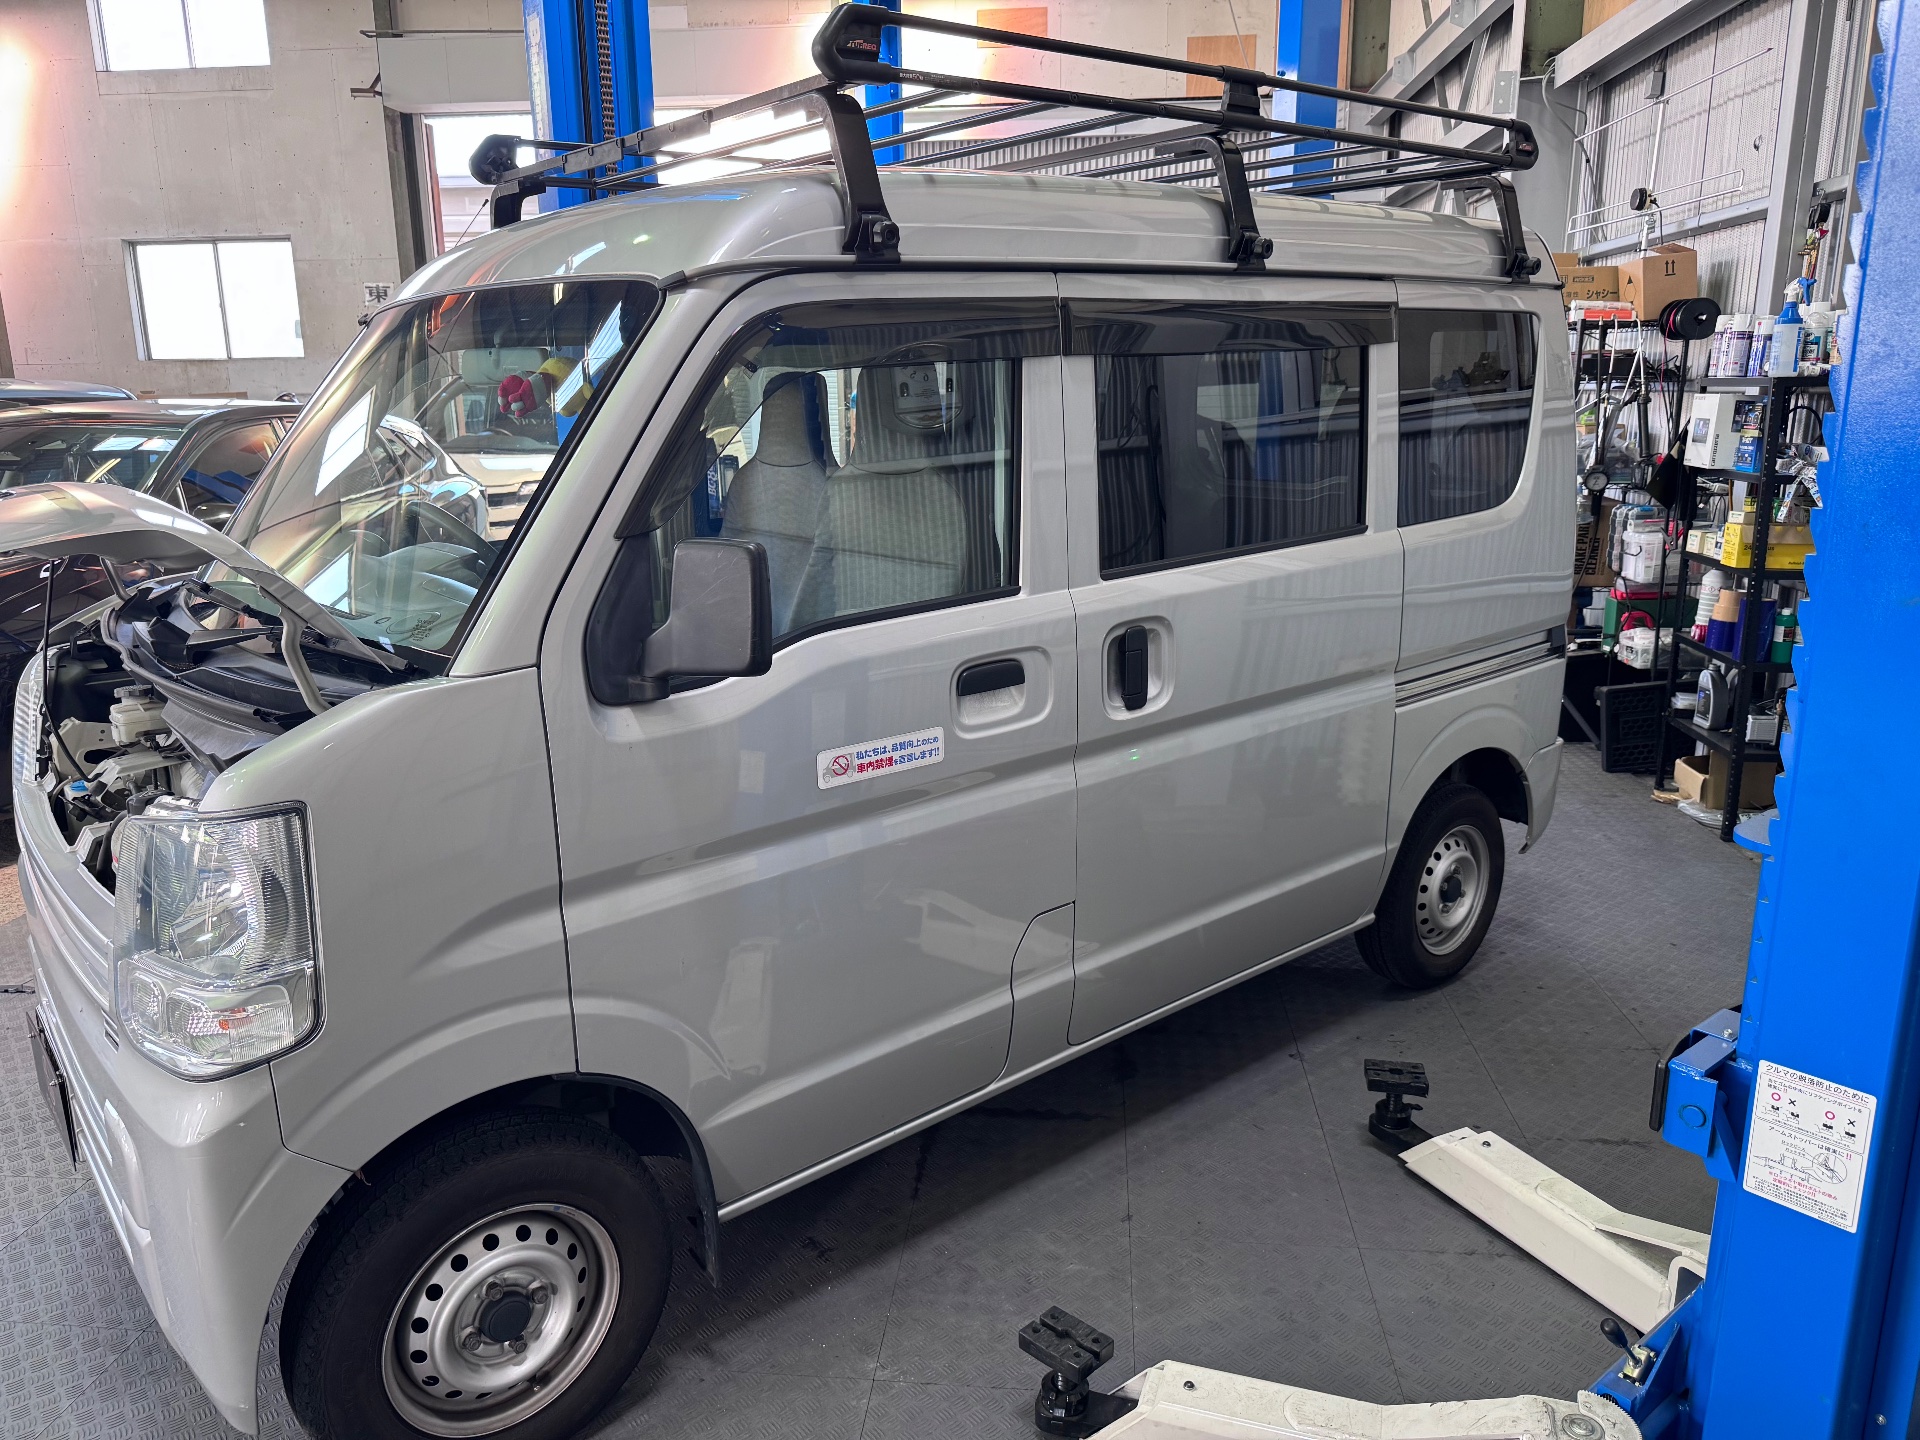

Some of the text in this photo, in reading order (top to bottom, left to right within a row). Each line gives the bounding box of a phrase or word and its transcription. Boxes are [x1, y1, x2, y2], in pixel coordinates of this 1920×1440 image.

[364, 284, 391, 303] 東
[1586, 288, 1618, 300] シャシー
[855, 736, 939, 761] 私たちは、品質向上のため
[1765, 1063, 1869, 1104] クルマの脱落防止のために
